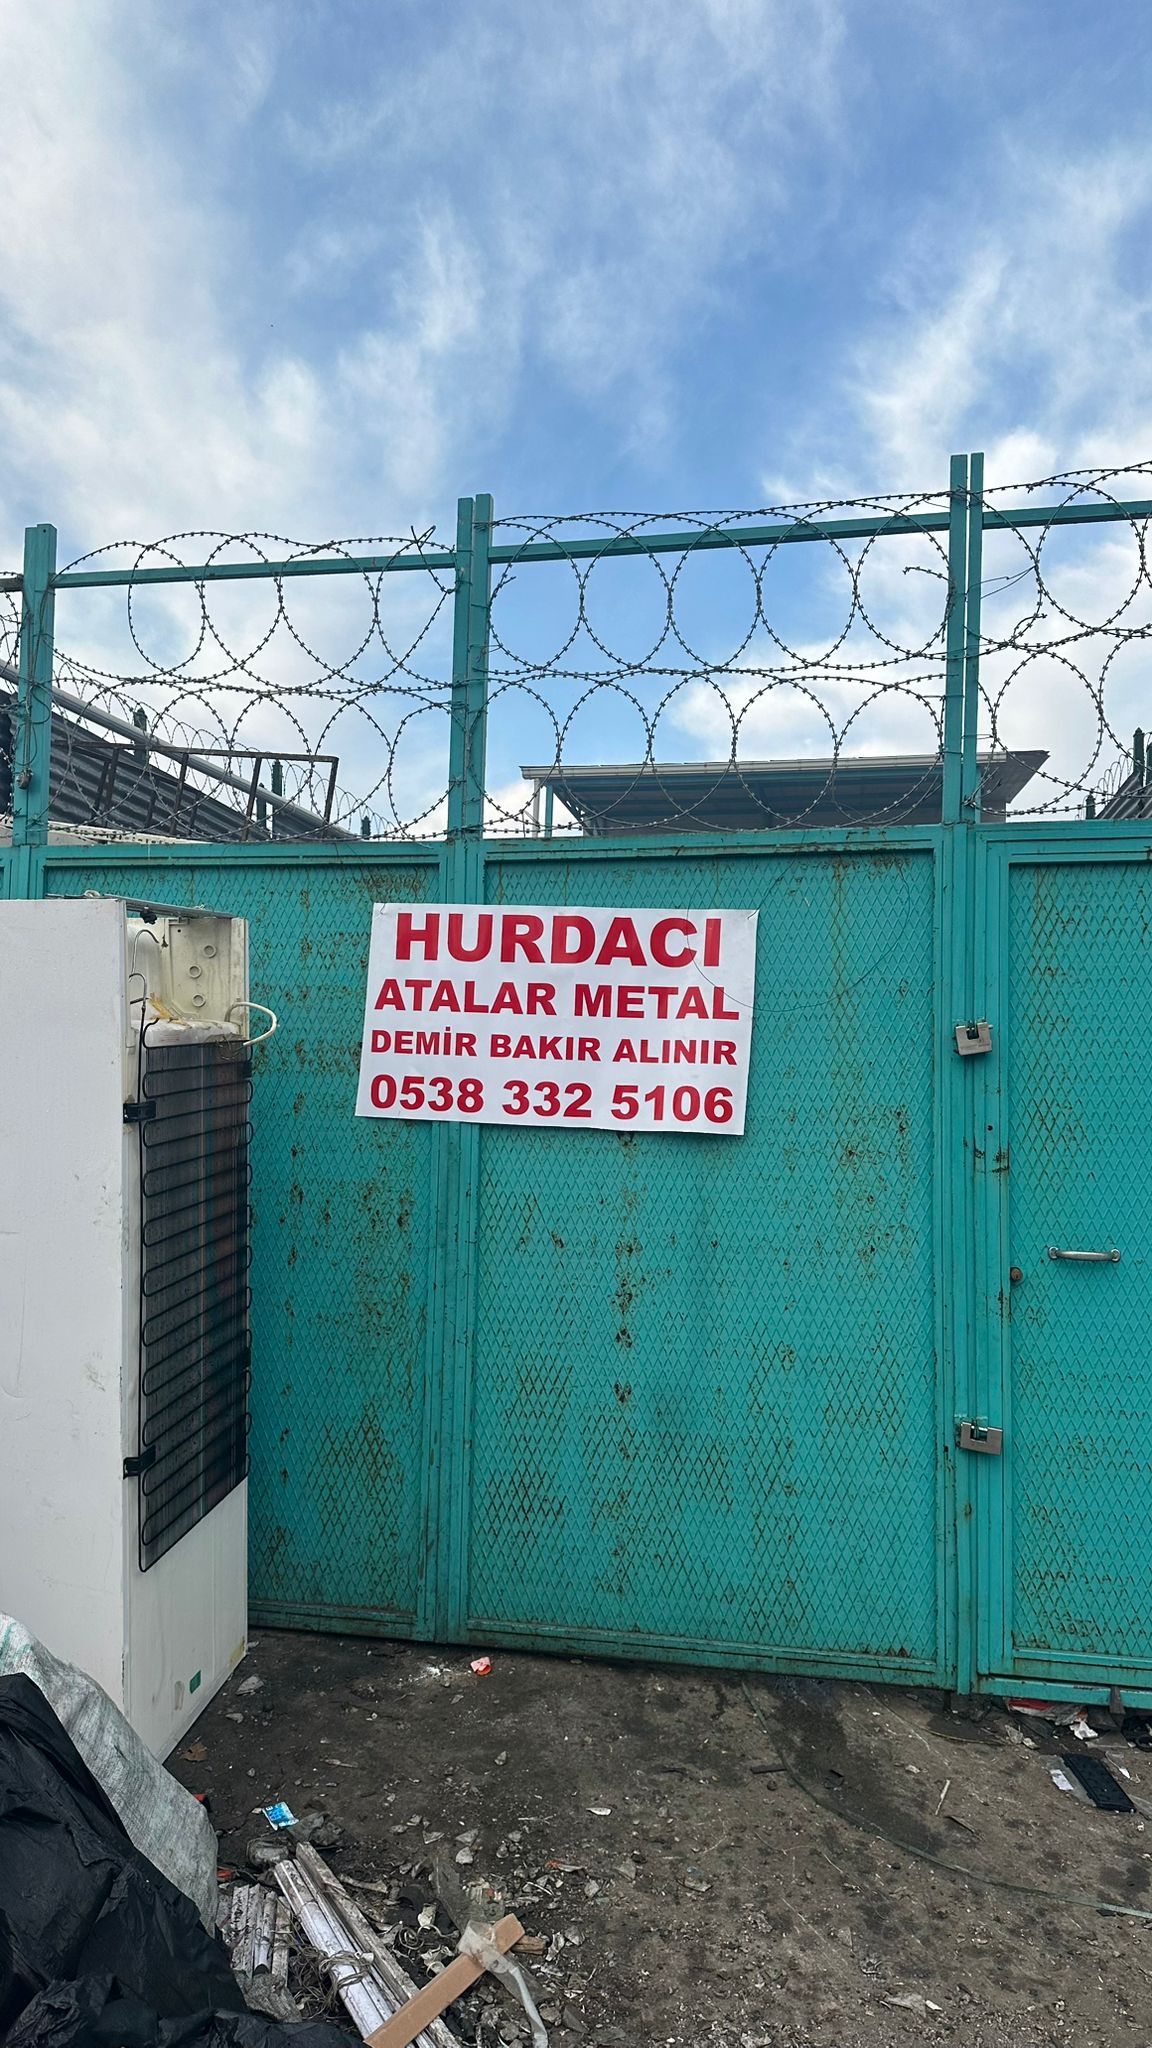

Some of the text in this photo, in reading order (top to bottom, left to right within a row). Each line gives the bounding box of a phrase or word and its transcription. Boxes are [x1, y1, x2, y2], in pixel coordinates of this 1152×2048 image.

[395, 912, 722, 968] HURDACI
[374, 978, 740, 1021] ATALAR METAL
[370, 1026, 738, 1066] DEMİR BAKIR ALINIR
[370, 1074, 734, 1125] 0538 332 5106
